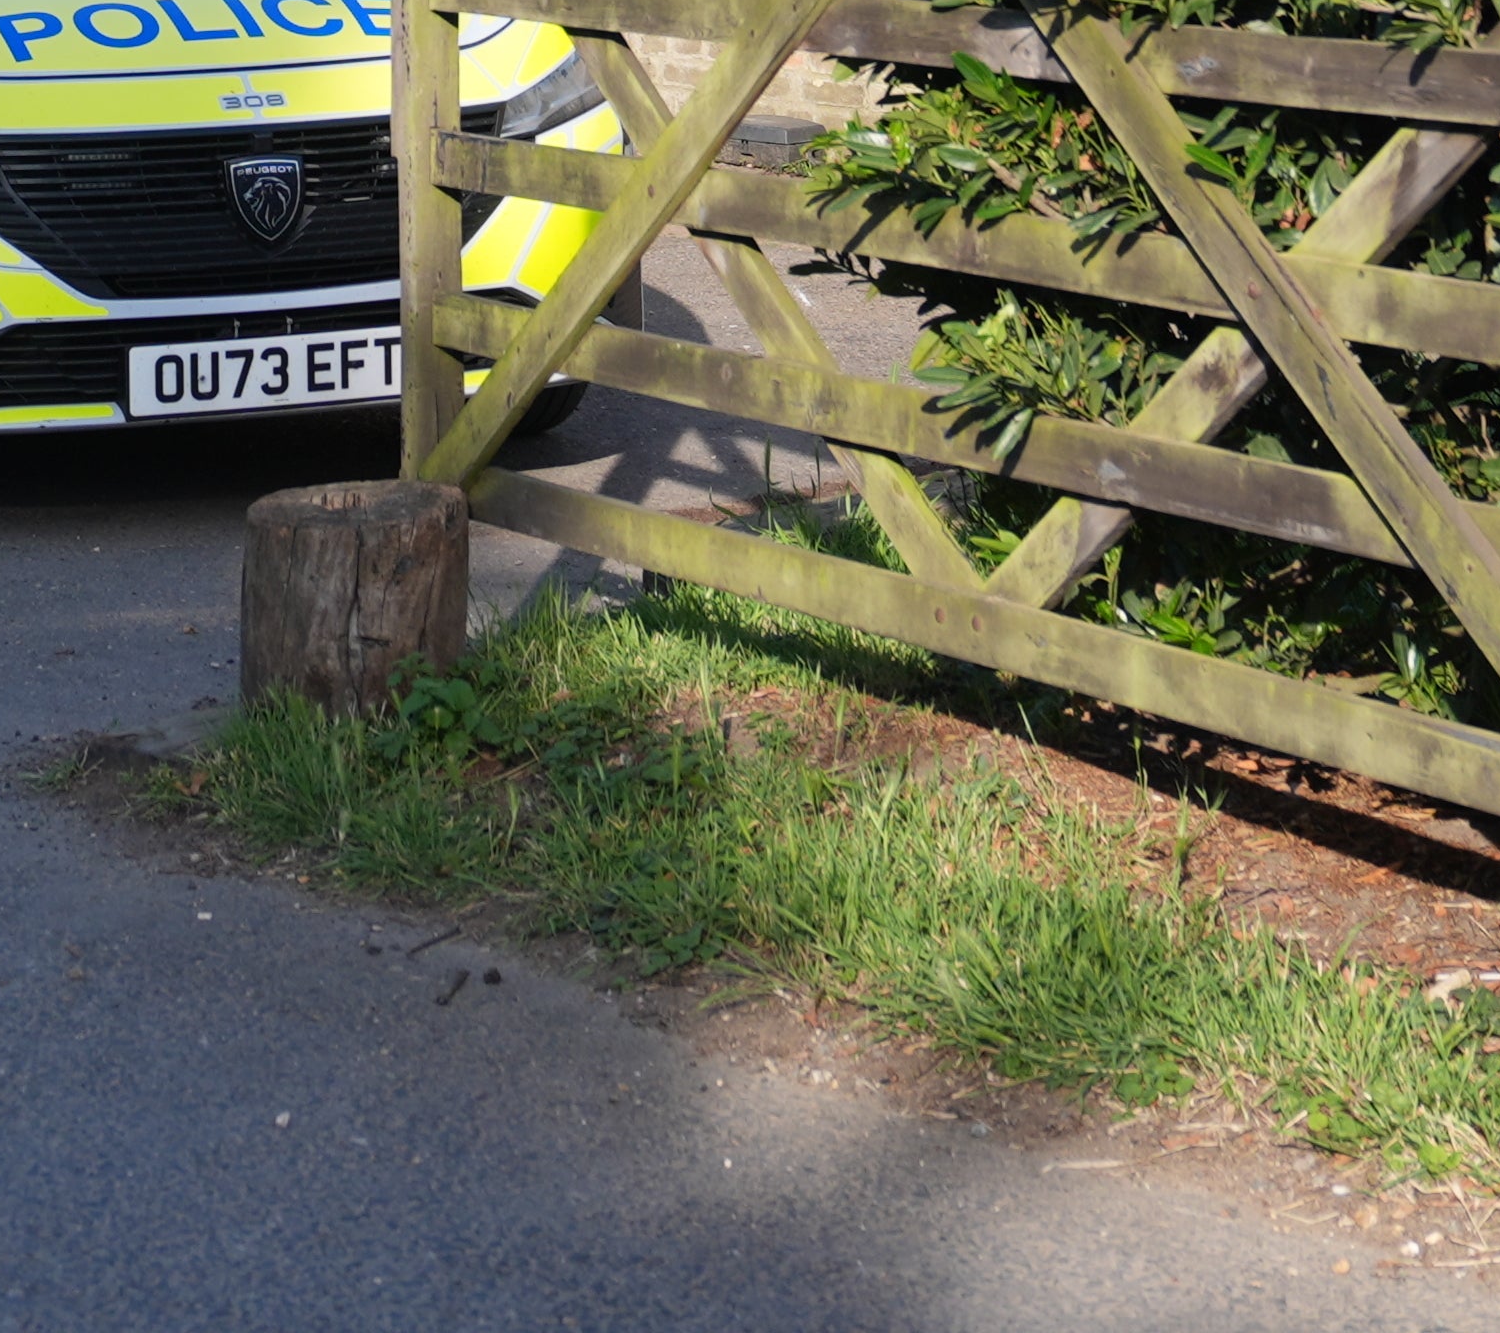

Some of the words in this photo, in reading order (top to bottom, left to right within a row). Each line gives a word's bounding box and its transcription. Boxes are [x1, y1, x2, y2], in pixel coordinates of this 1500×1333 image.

[222, 94, 285, 109] 308
[236, 165, 293, 176] PEUGEOT
[155, 346, 290, 404] OU73
[306, 337, 401, 393] EFT
